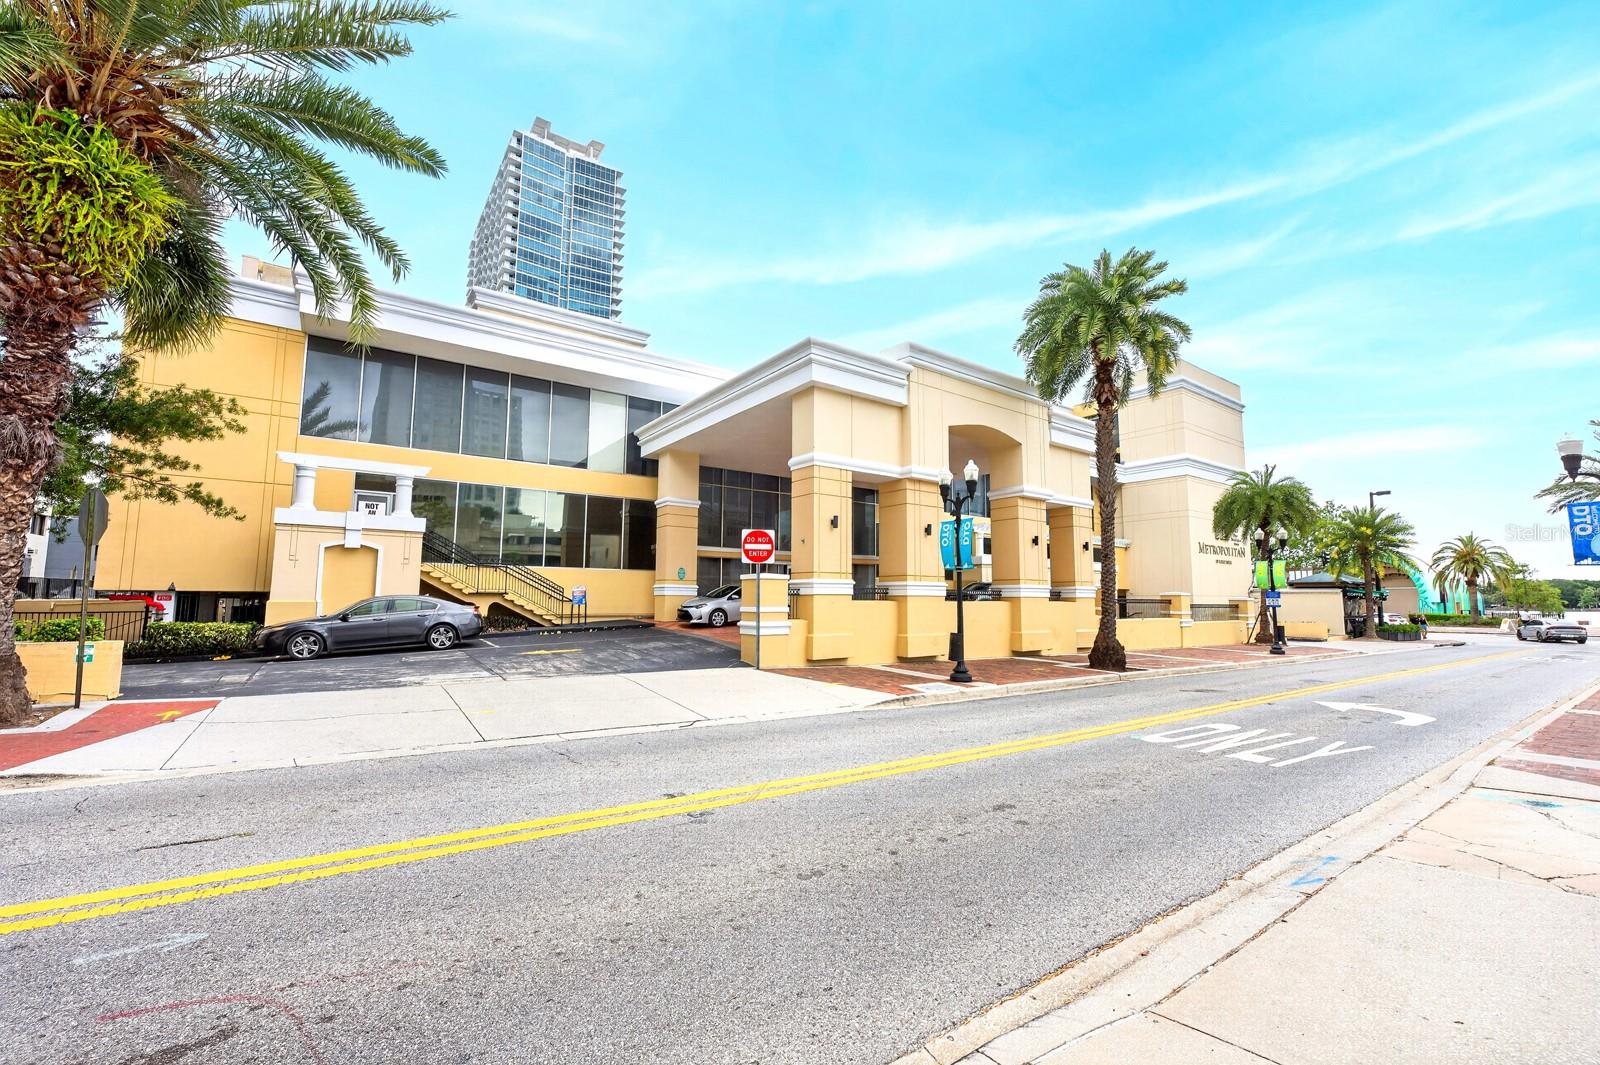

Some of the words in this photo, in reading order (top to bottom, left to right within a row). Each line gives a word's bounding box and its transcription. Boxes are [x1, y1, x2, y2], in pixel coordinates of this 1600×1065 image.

[365, 502, 380, 510] NOT
[1572, 506, 1593, 536] DTO
[941, 524, 950, 547] DTO
[962, 521, 971, 545] DTO
[1198, 541, 1246, 558] METROPOLITAN
[1140, 723, 1375, 768] ONLY
